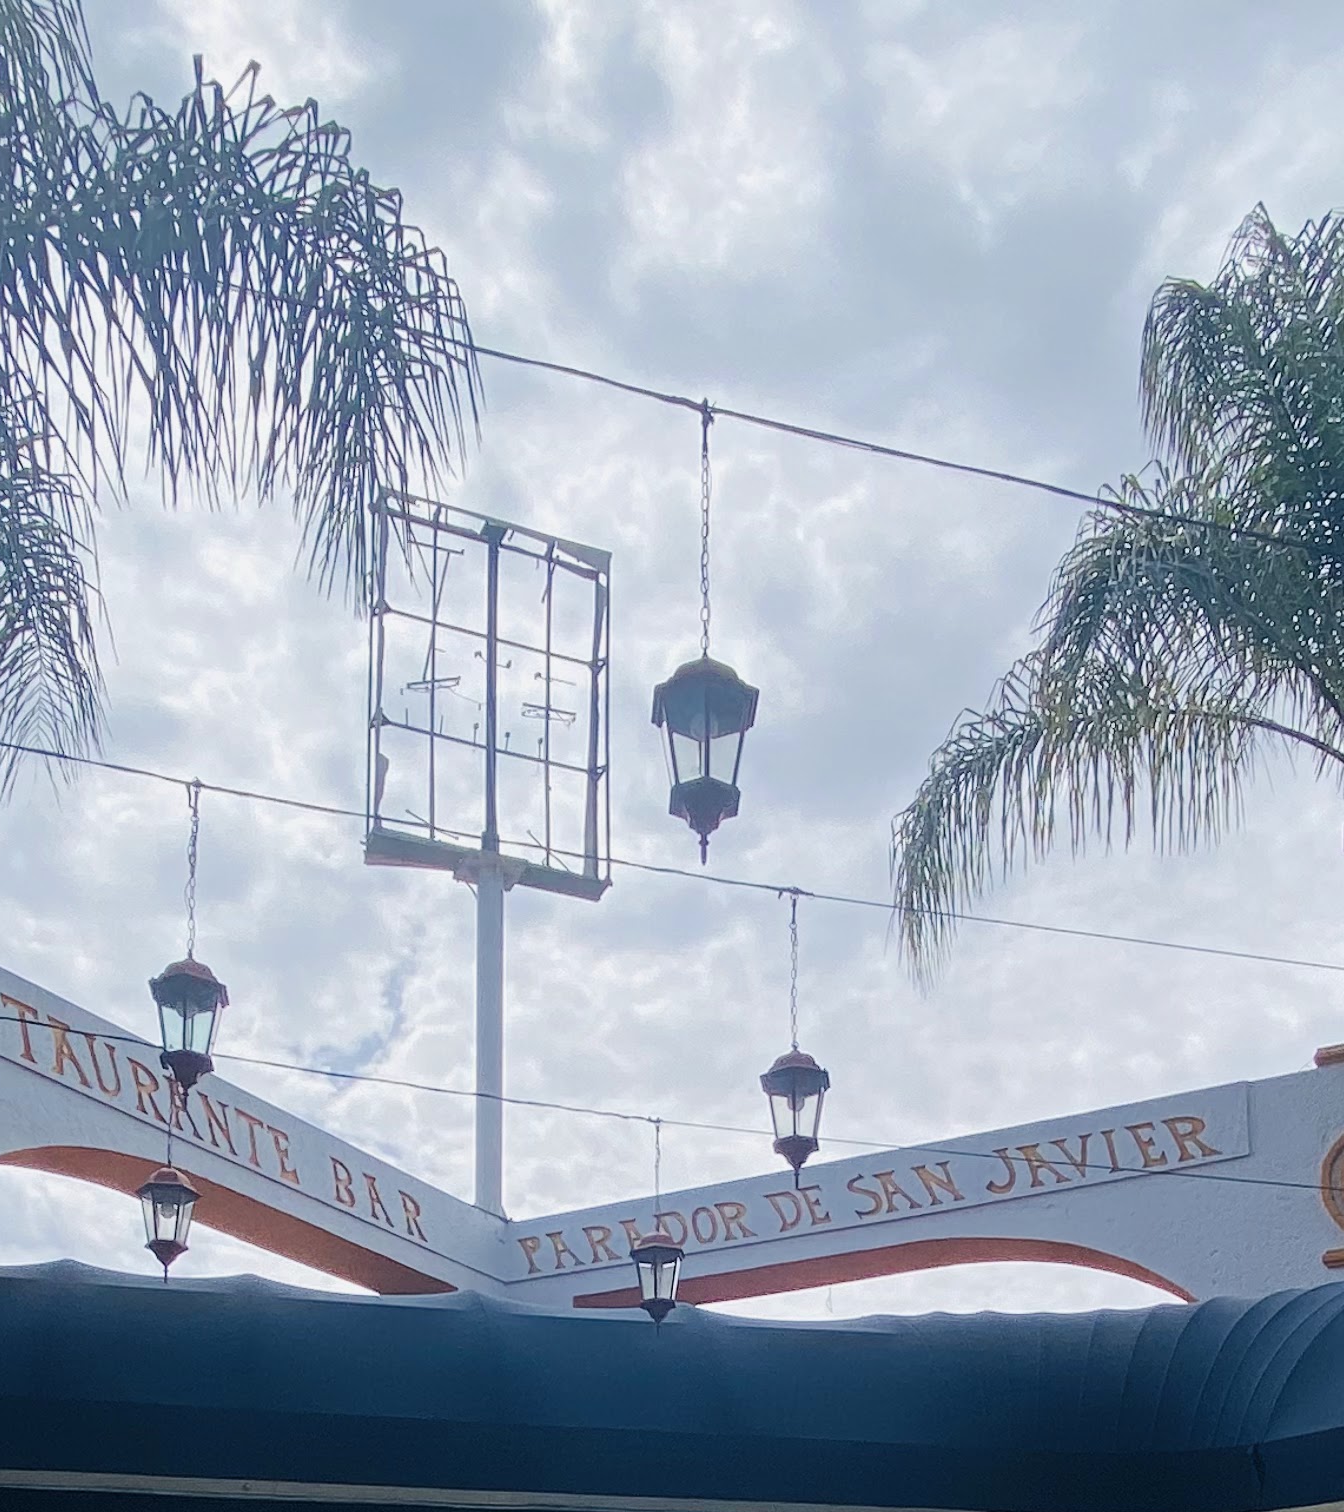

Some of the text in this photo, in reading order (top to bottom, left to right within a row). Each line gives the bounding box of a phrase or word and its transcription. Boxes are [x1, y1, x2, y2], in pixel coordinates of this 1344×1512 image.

[329, 1155, 428, 1242] BAR
[765, 1184, 833, 1233] DE
[846, 1160, 965, 1218] SAN
[986, 1115, 1223, 1195] JAVIER
